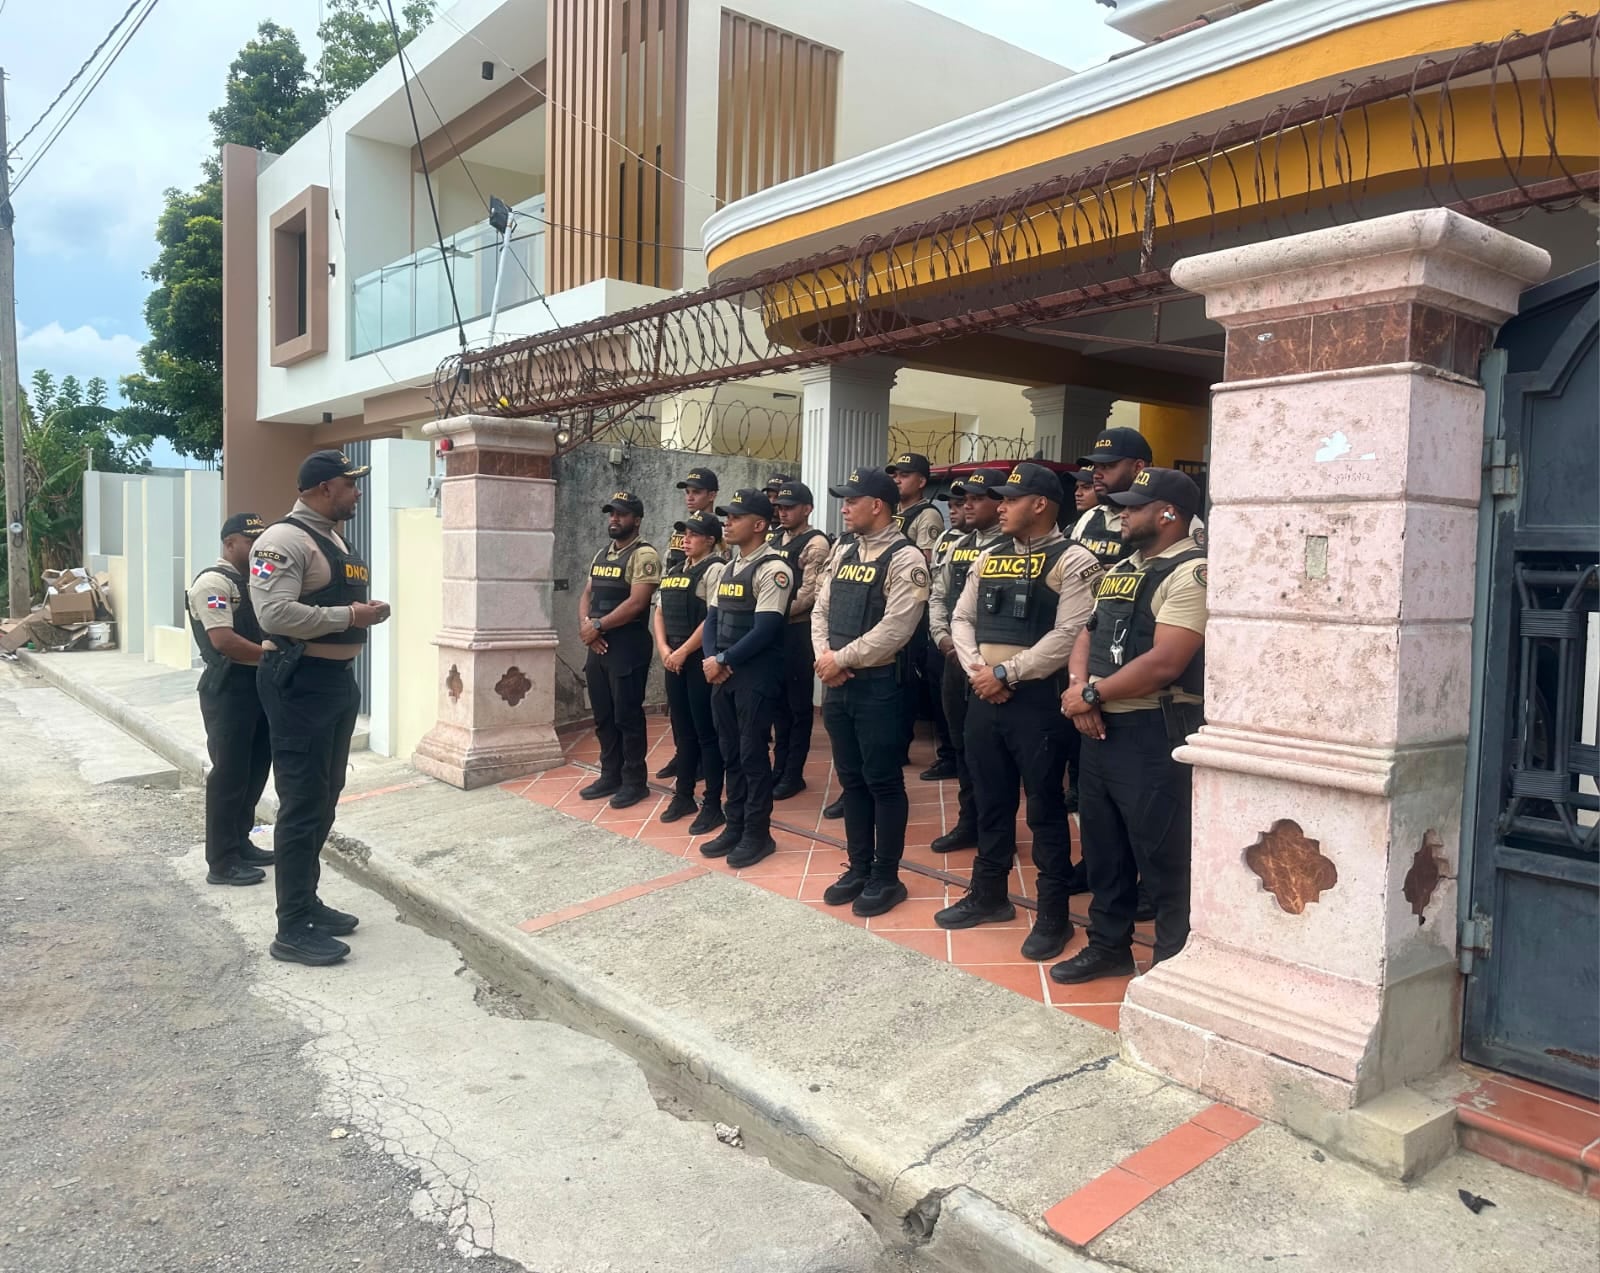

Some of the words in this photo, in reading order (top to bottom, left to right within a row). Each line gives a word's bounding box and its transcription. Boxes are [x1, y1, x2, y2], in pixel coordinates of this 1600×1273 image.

[952, 549, 980, 562] DNC
[592, 565, 621, 578] DNCD
[836, 564, 876, 583] DNCD
[660, 577, 691, 589] DNCD
[1100, 577, 1136, 596] DNCD
